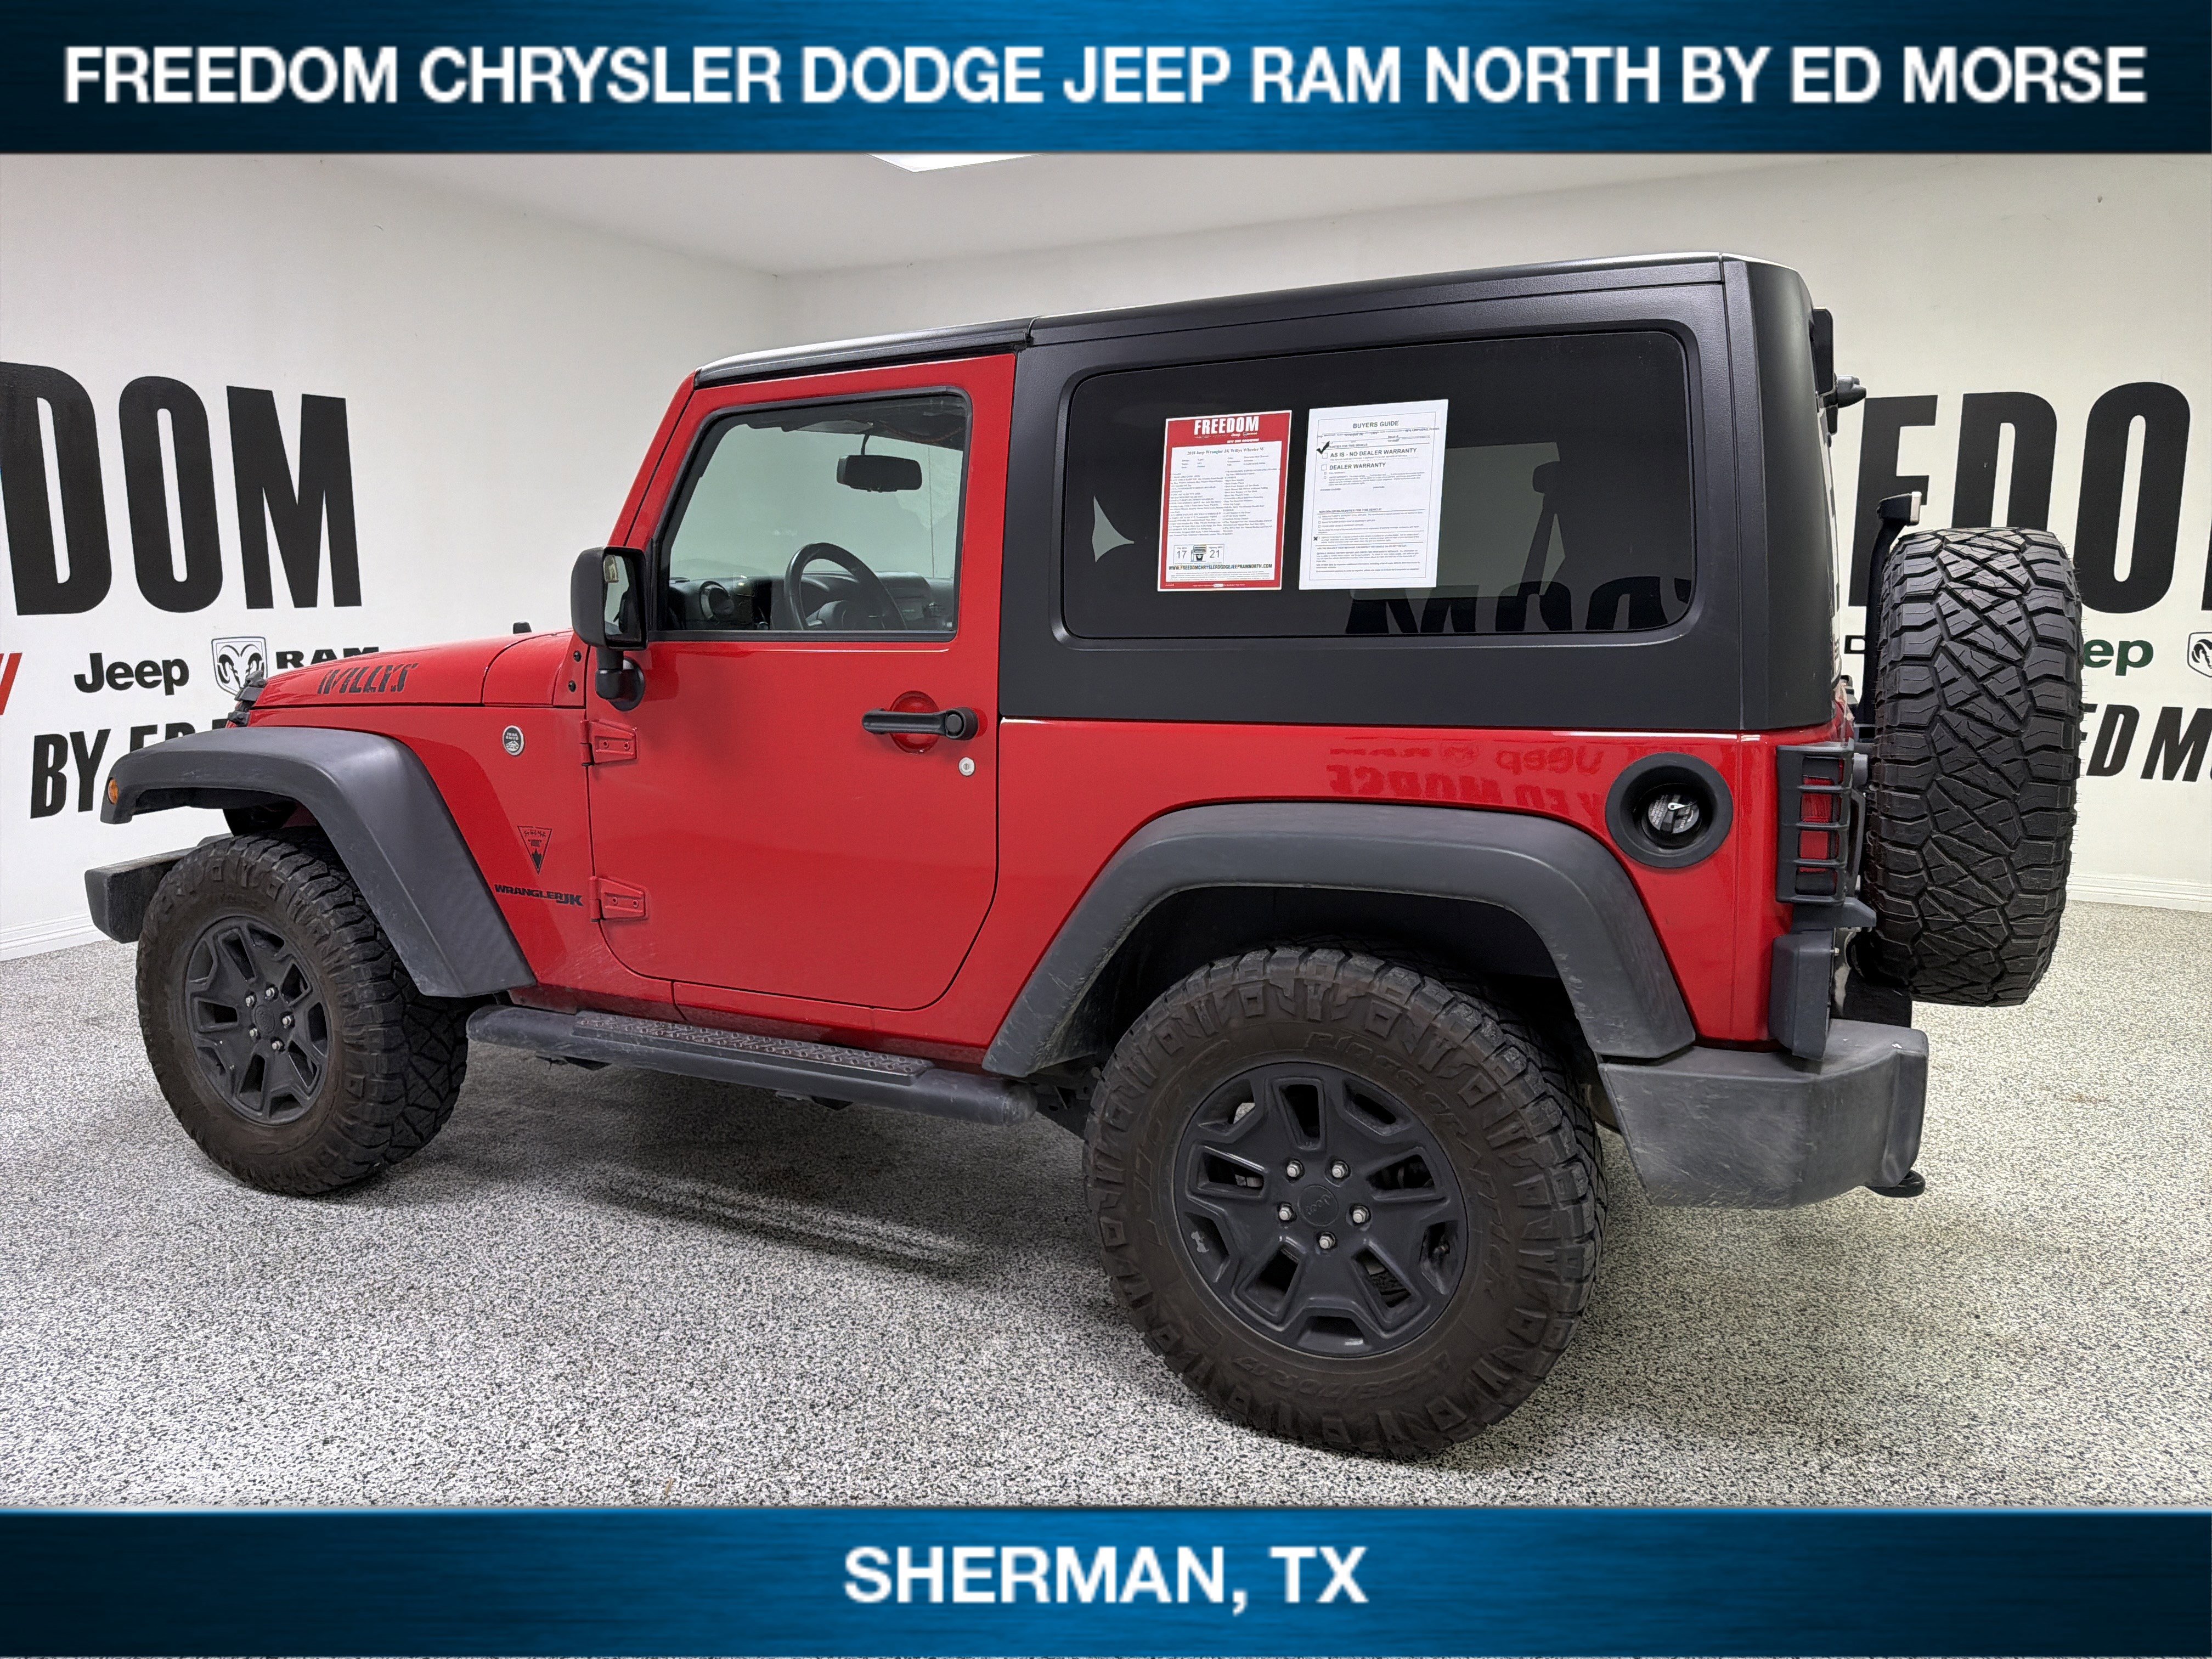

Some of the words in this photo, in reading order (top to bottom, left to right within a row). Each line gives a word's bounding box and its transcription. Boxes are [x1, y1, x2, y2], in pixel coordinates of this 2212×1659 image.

[1194, 416, 1259, 435] FREEDOM
[1848, 382, 2212, 613] EDO
[1177, 550, 1187, 558] 17
[1209, 550, 1220, 558] 21
[74, 653, 189, 695] Jeep
[317, 662, 419, 695] WILLYS
[30, 729, 111, 819] BY
[494, 884, 565, 900] WRANGLER
[556, 892, 584, 906] JK
